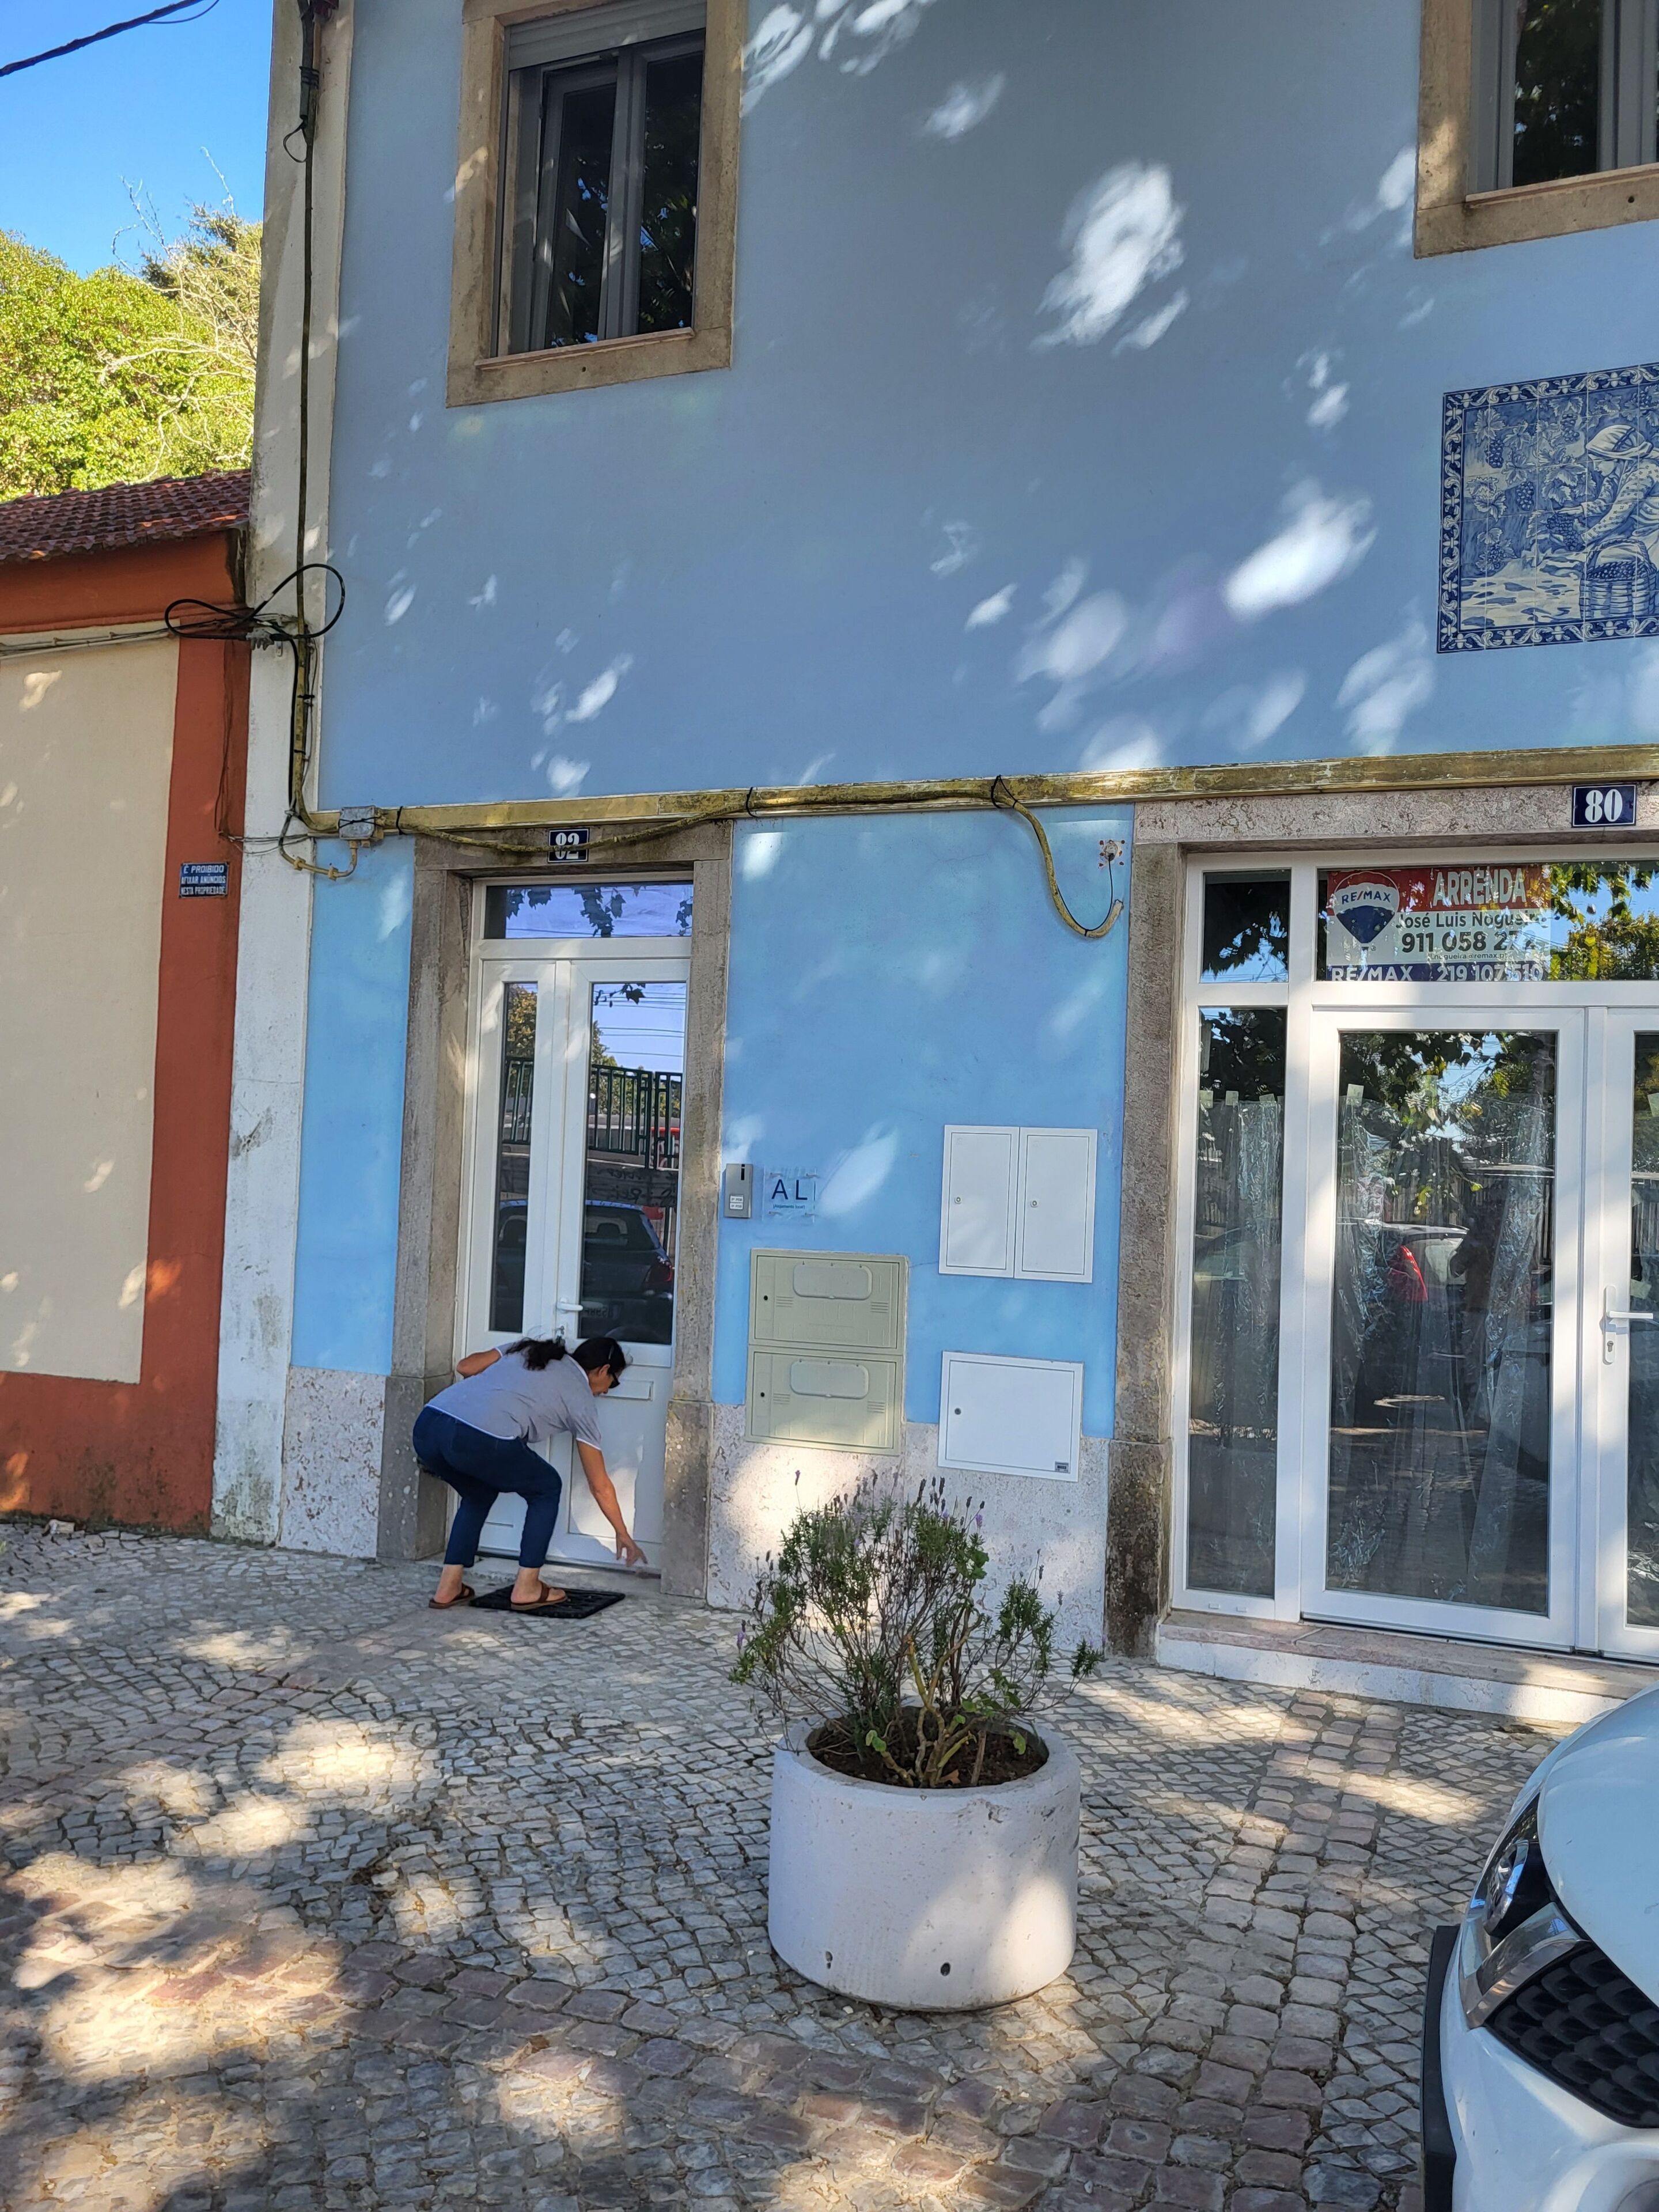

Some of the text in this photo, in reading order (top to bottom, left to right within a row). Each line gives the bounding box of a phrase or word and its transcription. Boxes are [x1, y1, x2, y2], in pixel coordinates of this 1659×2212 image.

[1585, 789, 1623, 823] 80
[183, 863, 225, 874] É PROIBIDO
[181, 876, 199, 885] AFIXAR
[1433, 868, 1527, 907] ARRENDA
[1341, 890, 1391, 905] RE/MAX
[1395, 912, 1430, 929] José
[1436, 912, 1467, 927] Luis
[1402, 932, 1434, 953] 911
[1442, 931, 1486, 952] 058
[1331, 966, 1414, 982] RE/MAX
[1437, 965, 1468, 982] 219
[1475, 964, 1505, 981] 107
